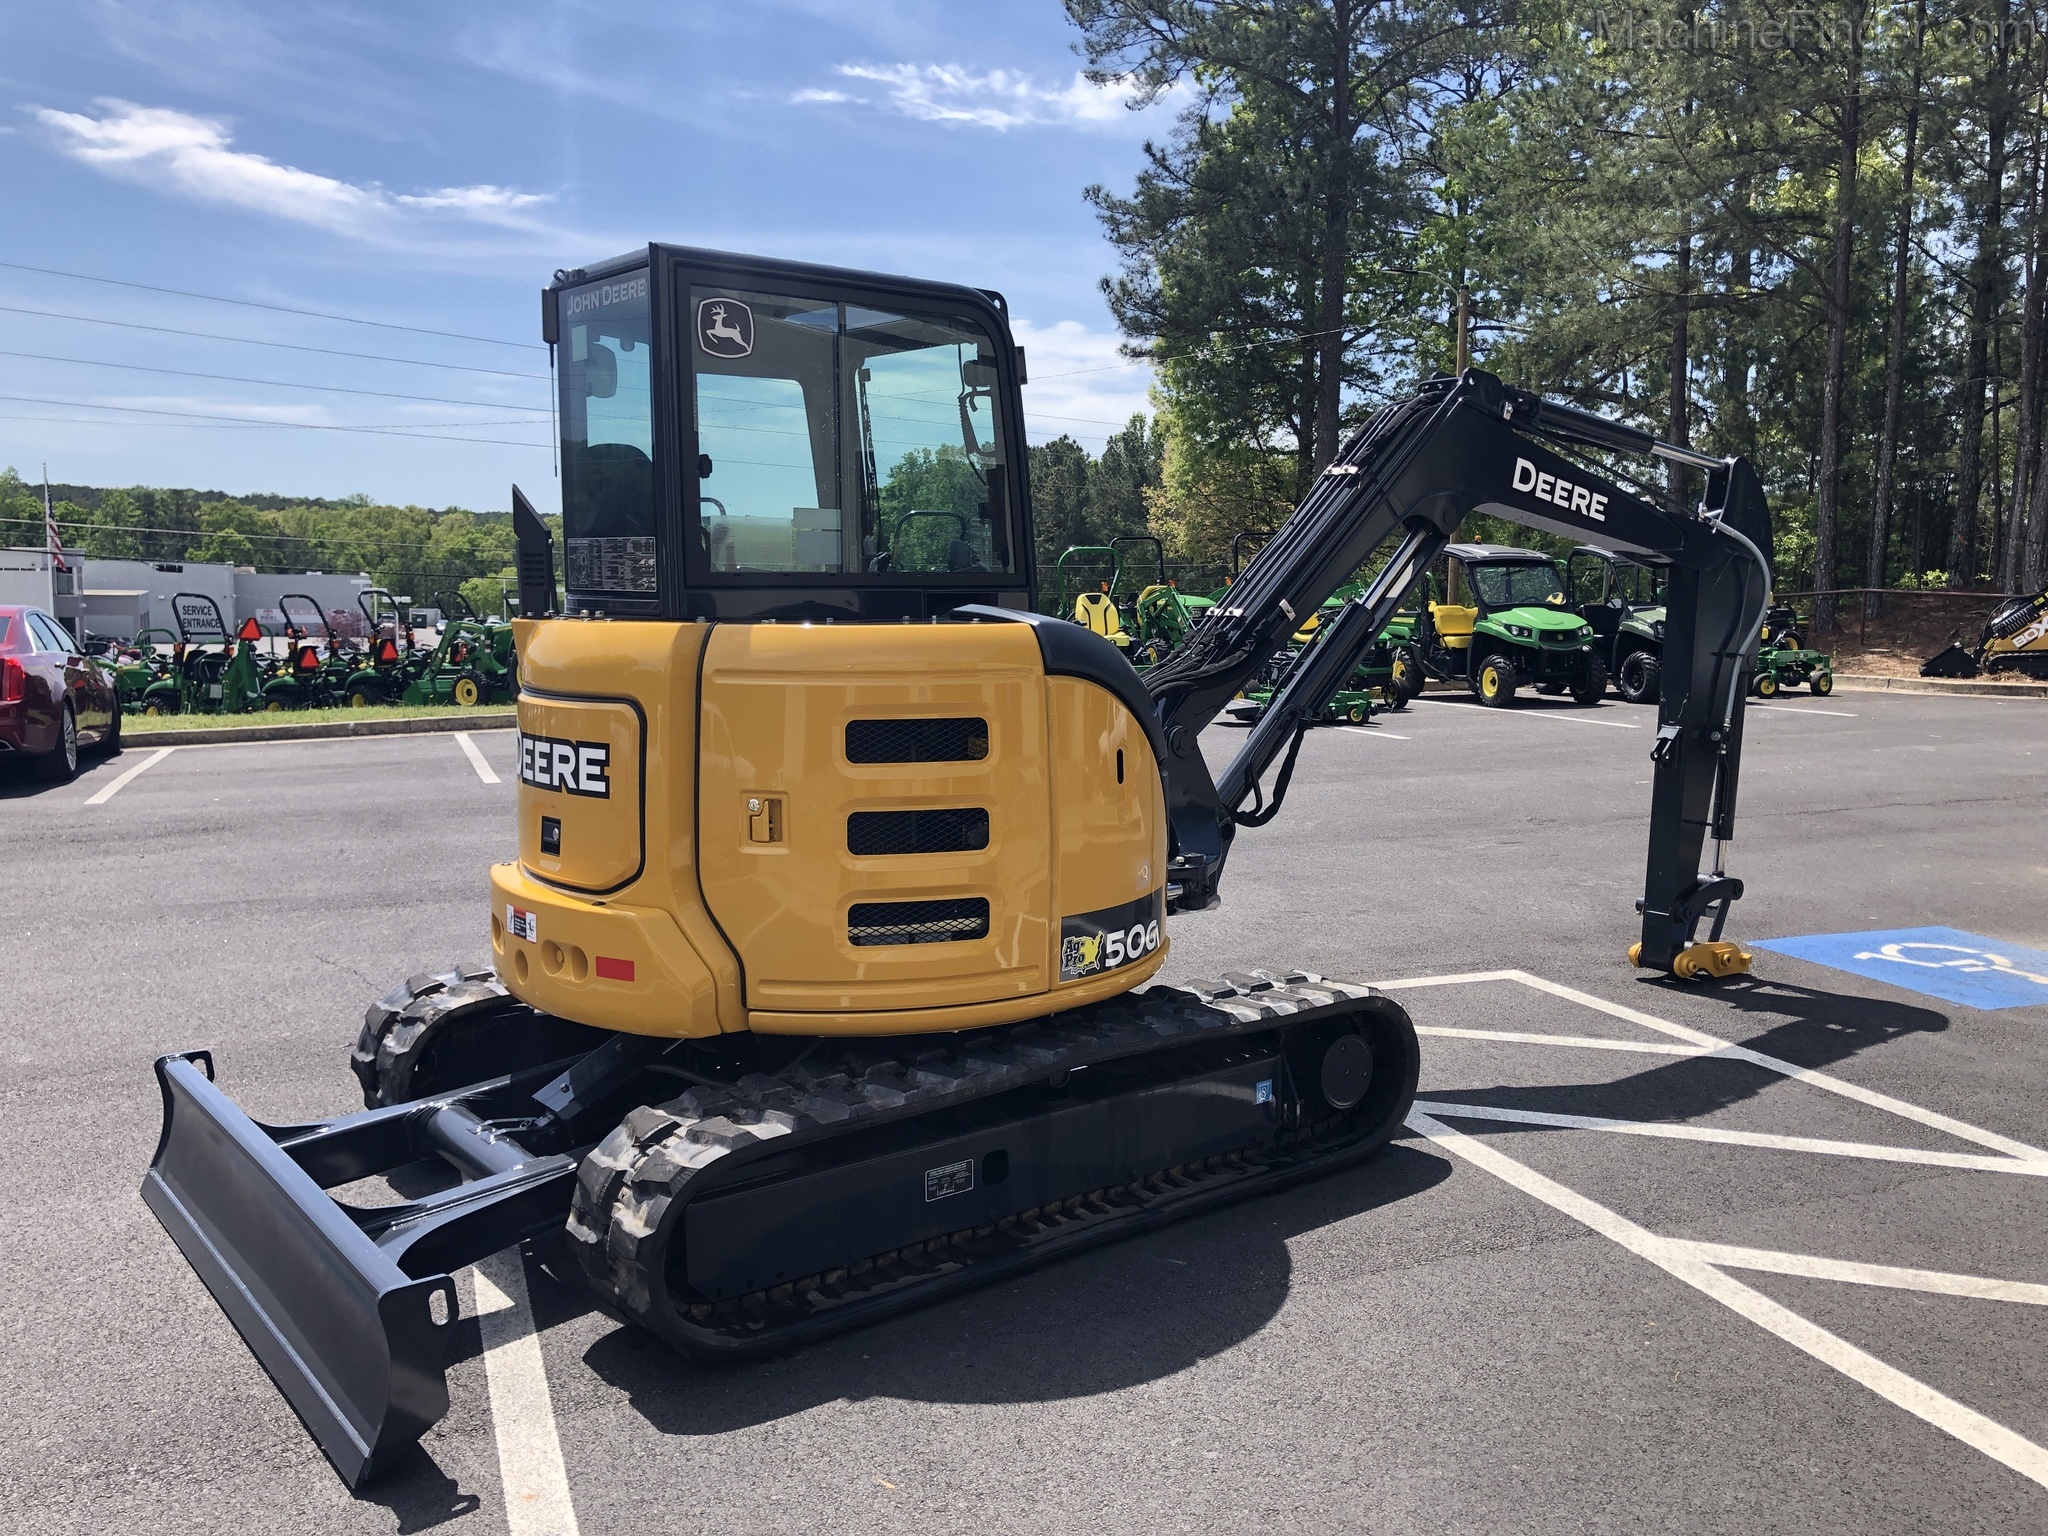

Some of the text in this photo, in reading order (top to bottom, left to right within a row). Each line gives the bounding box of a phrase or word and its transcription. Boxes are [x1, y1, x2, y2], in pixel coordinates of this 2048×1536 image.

[567, 278, 647, 315] JOHN DEERE
[1512, 457, 1609, 522] DEERE
[182, 605, 212, 616] SERVICE
[183, 618, 221, 629] ENTRANCE
[1105, 919, 1160, 968] 50G
[1064, 953, 1085, 968] Pro
